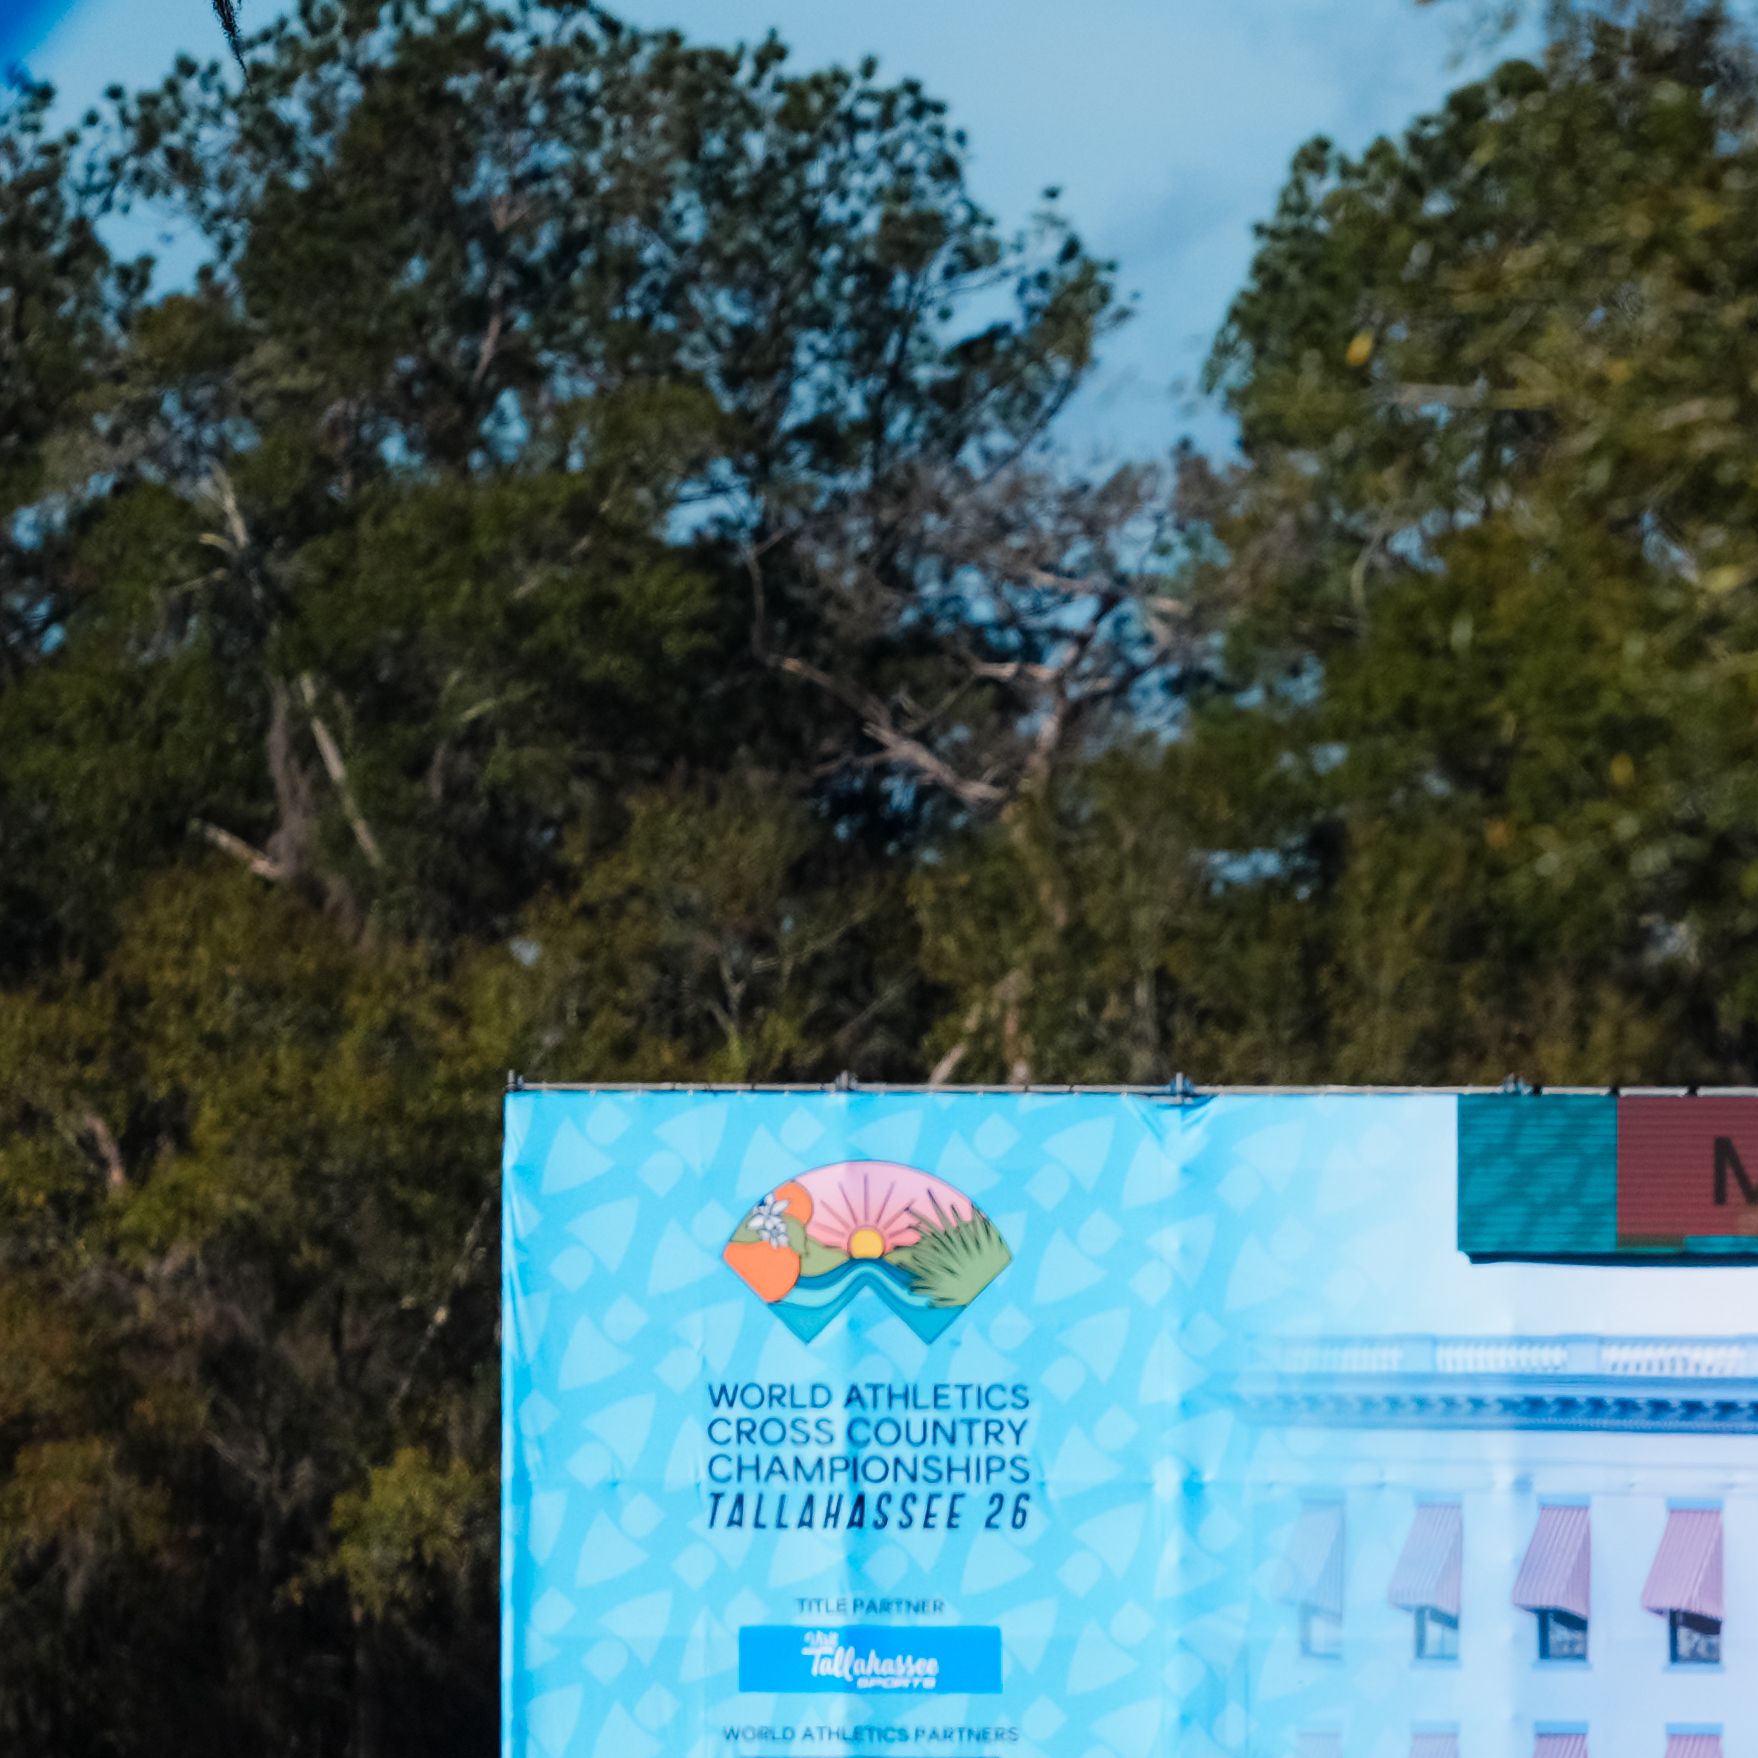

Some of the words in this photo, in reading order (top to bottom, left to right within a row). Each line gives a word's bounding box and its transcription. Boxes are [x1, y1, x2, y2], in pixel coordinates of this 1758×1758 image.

[708, 1383, 831, 1410] WORLD
[843, 1383, 1031, 1410] ATHLETICS
[707, 1418, 835, 1447] CROSS
[846, 1418, 1029, 1447] COUNTRY
[707, 1455, 1032, 1485] CHAMPIONSHIPS
[708, 1491, 962, 1530] TALLAHASSEE
[984, 1491, 1031, 1530] 26
[796, 1598, 846, 1615] TITLE
[852, 1598, 945, 1615] PARTNER
[802, 1647, 939, 1682] Tallahassee
[724, 1726, 796, 1743] WORLD
[802, 1726, 909, 1743] ATHLETICS
[914, 1726, 1020, 1743] PARTNERS
